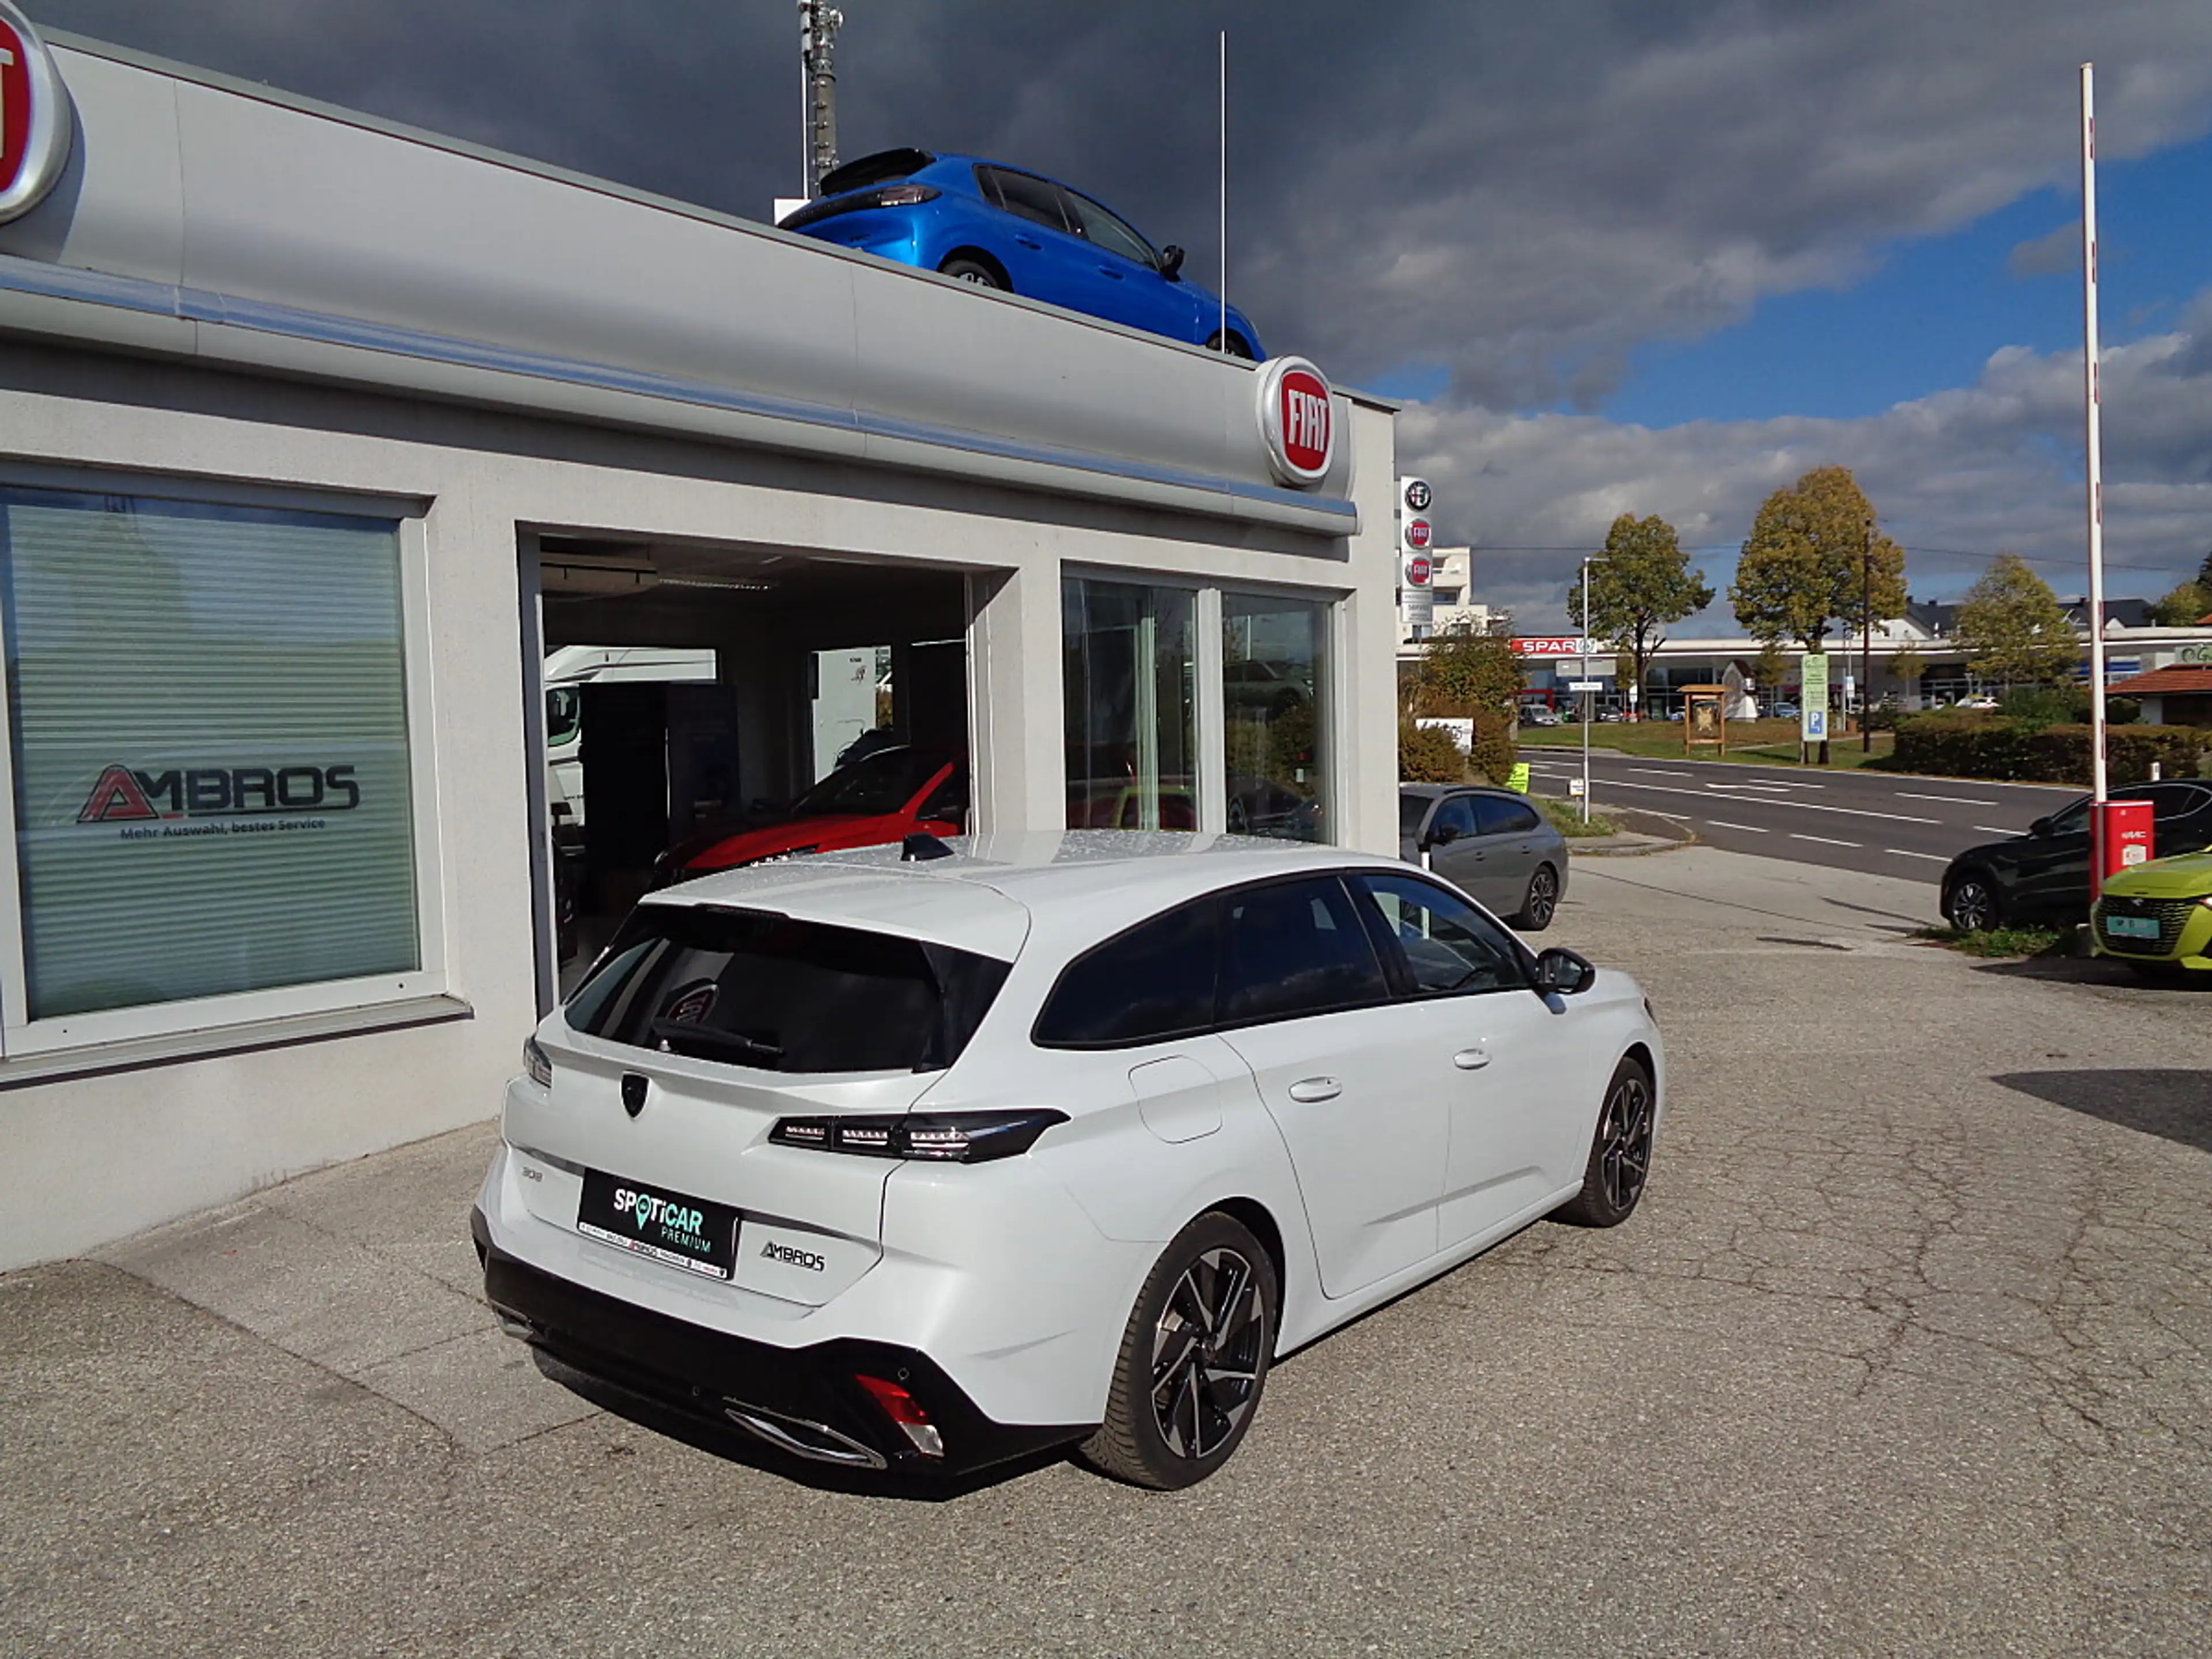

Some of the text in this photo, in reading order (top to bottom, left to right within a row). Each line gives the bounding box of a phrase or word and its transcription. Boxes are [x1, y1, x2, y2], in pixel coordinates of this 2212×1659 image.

[1288, 388, 1328, 452] FIAT
[1522, 641, 1577, 652] SPAR
[76, 764, 361, 823] AMBROS
[120, 816, 326, 840] Mehr Auswahl, bestes Service
[661, 1226, 711, 1253] PREMIUM
[760, 1241, 825, 1271] AMBROS
